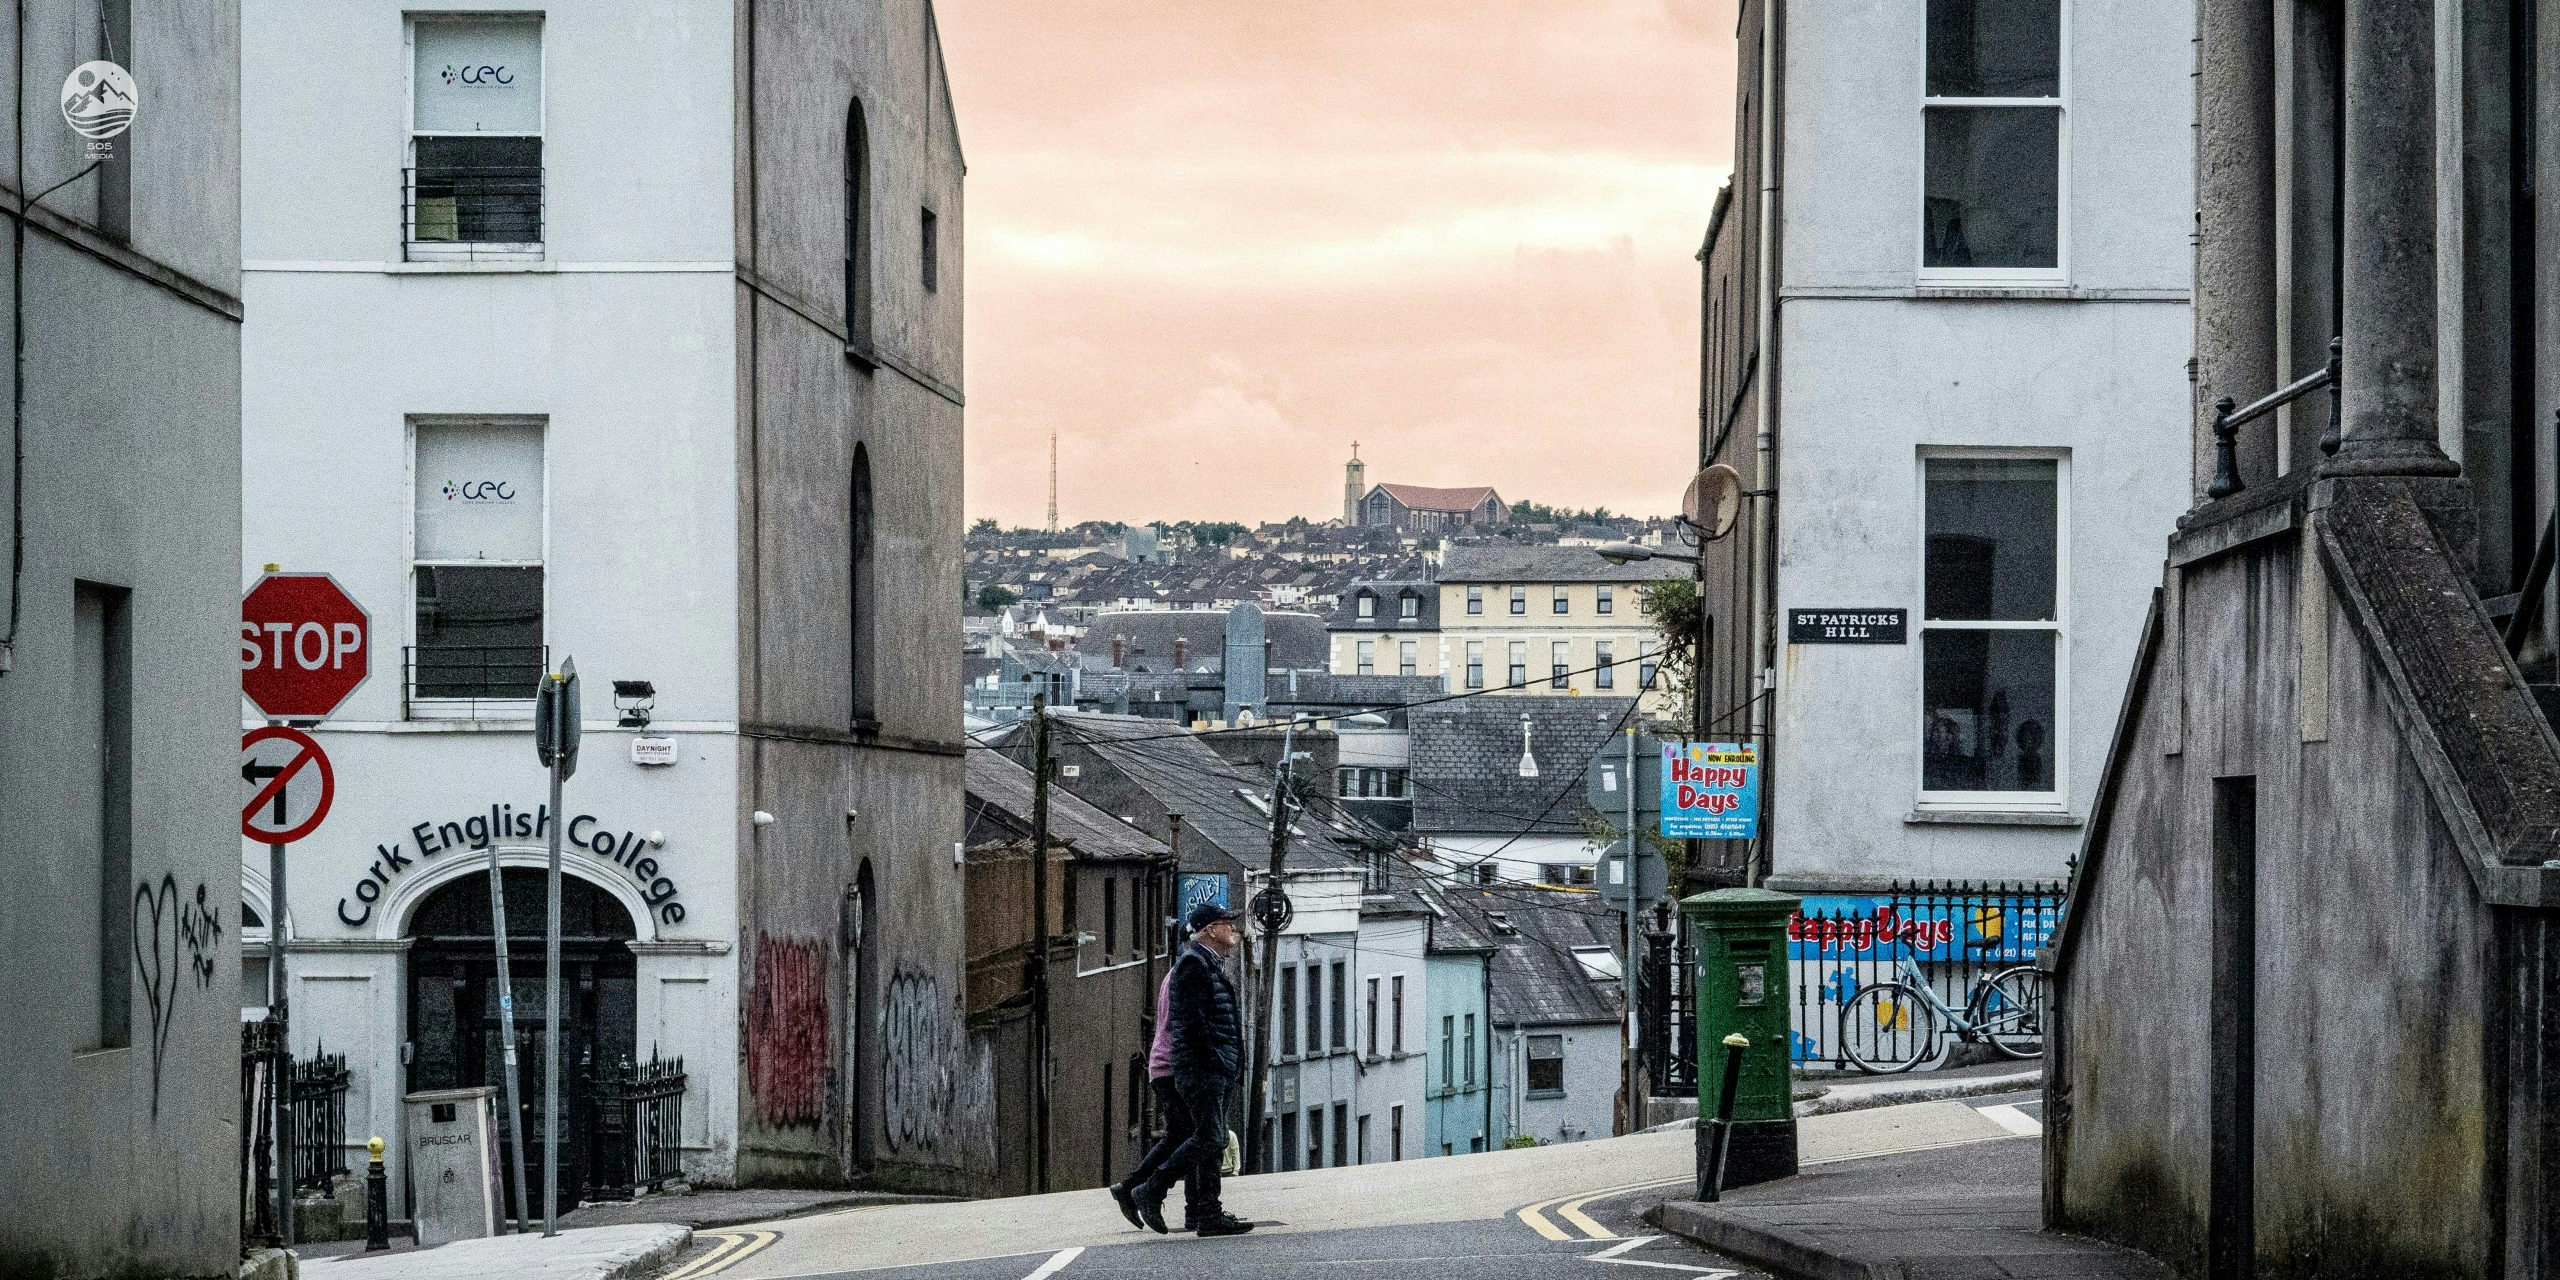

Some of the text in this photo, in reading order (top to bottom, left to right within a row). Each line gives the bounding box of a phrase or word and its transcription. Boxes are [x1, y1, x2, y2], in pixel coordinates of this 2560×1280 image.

[1797, 614, 1899, 626] ST PATRICKS
[1825, 626, 1870, 638] HILL
[242, 621, 362, 671] STOP
[1707, 754, 1755, 763] NOW ENROLLING
[1671, 757, 1747, 789] Happy
[1677, 784, 1740, 815] Days
[338, 803, 686, 927] Cork English College
[1787, 906, 1954, 952] Happy Days
[2022, 920, 2041, 929] FUL
[420, 1134, 472, 1147] BRUSCAR
